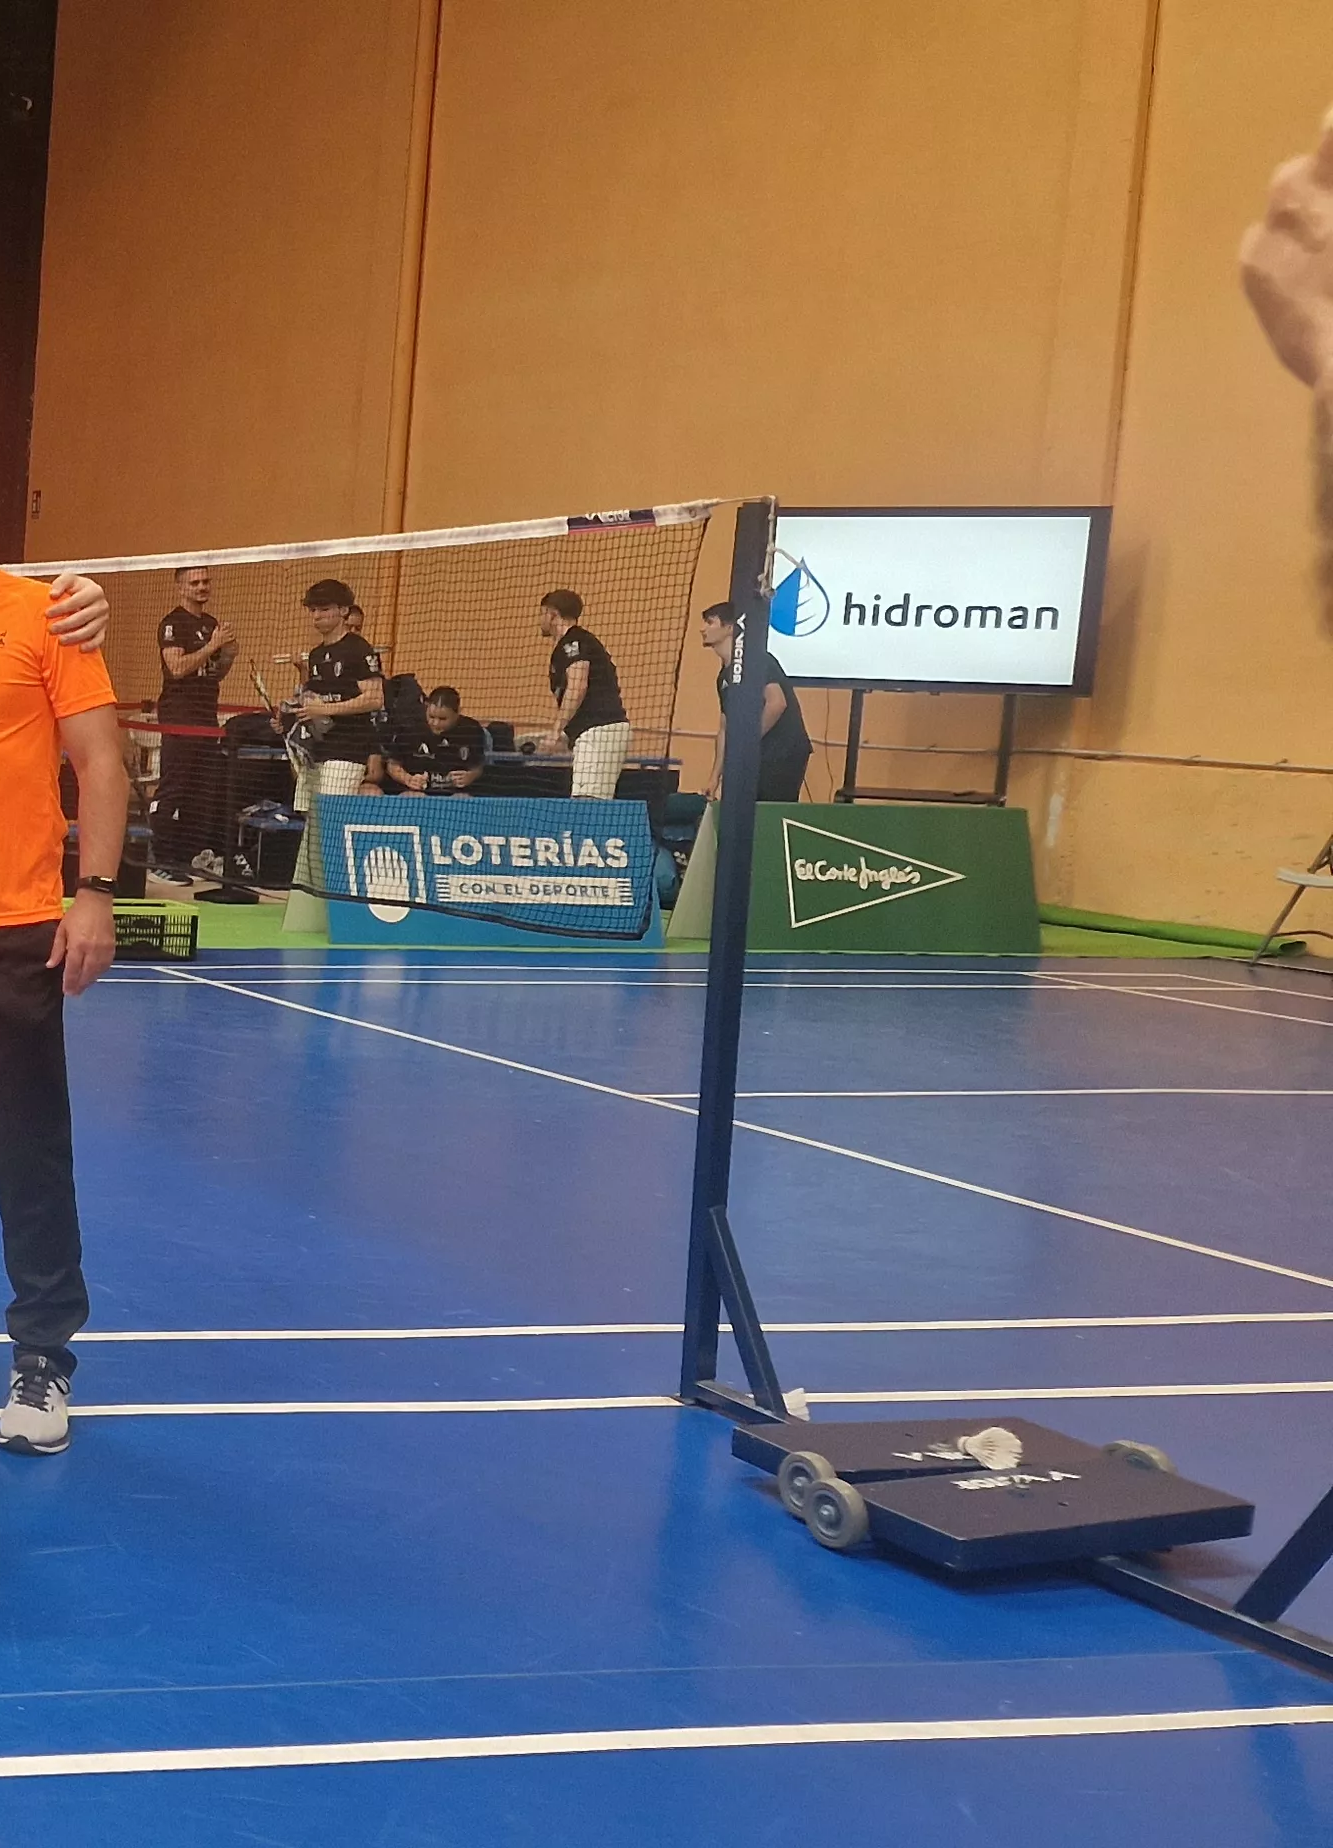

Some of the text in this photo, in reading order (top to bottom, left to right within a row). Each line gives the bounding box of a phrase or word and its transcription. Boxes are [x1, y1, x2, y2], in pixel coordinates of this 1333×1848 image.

[842, 591, 1060, 631] hidroman
[733, 632, 745, 685] VICTOR
[430, 830, 628, 868] LOTERÍAS
[459, 883, 610, 897] CON EL DEPORTE
[794, 856, 921, 890] El Corte Inglés
